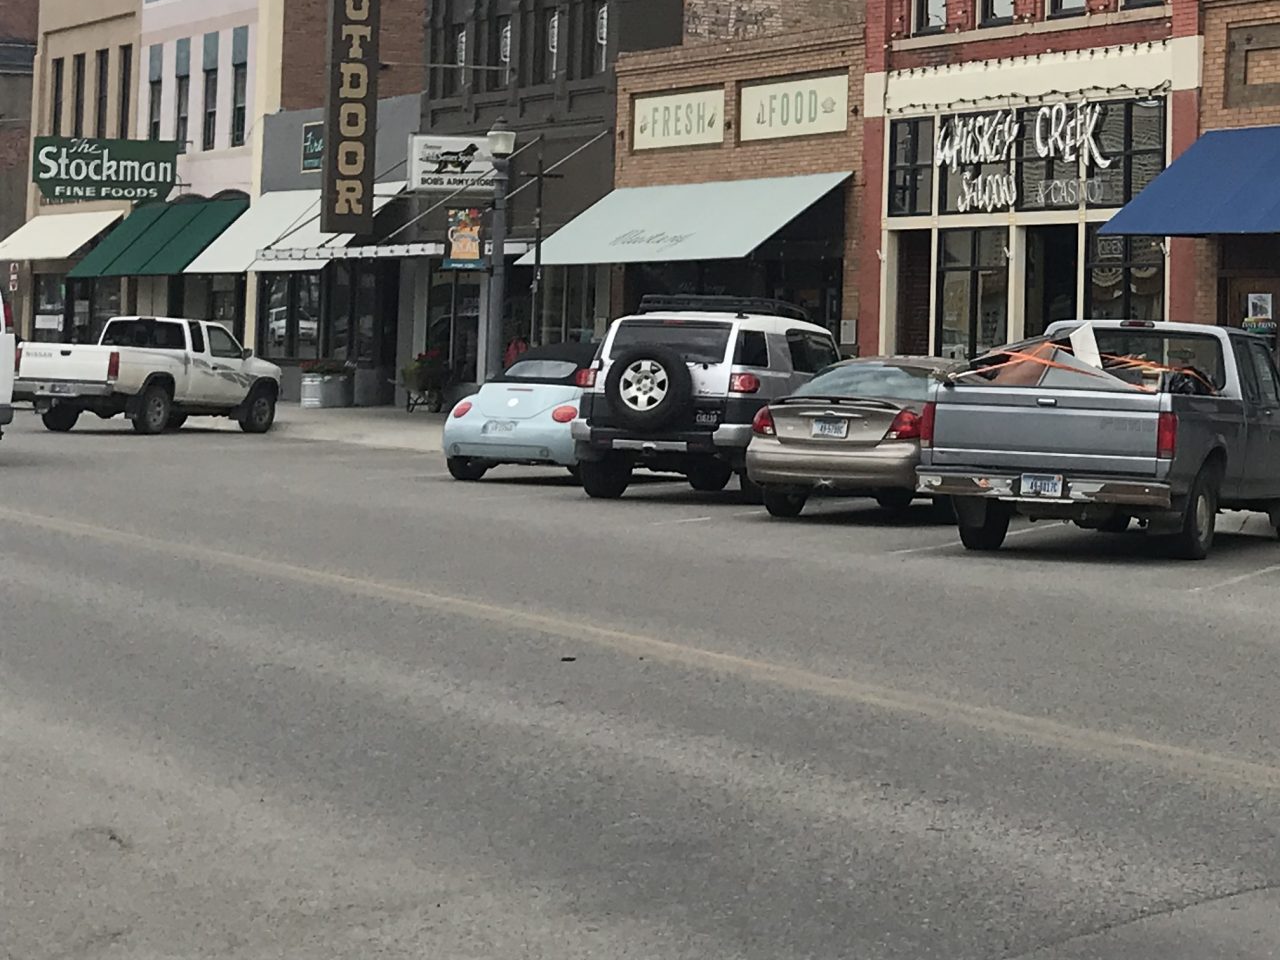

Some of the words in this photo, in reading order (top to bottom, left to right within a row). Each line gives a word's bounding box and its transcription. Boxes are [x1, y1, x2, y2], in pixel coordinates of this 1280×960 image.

[651, 102, 706, 137] FRESH
[769, 90, 818, 137] FOOD
[69, 139, 101, 154] The
[935, 110, 1020, 173] WHISKEY
[1035, 98, 1111, 168] CREEK
[38, 146, 172, 182] Stockman
[421, 177, 444, 185] BOB'S
[54, 186, 96, 196] FINE
[101, 187, 158, 197] FOODS
[957, 171, 1017, 212] SALOON
[1050, 178, 1104, 204] CASINO
